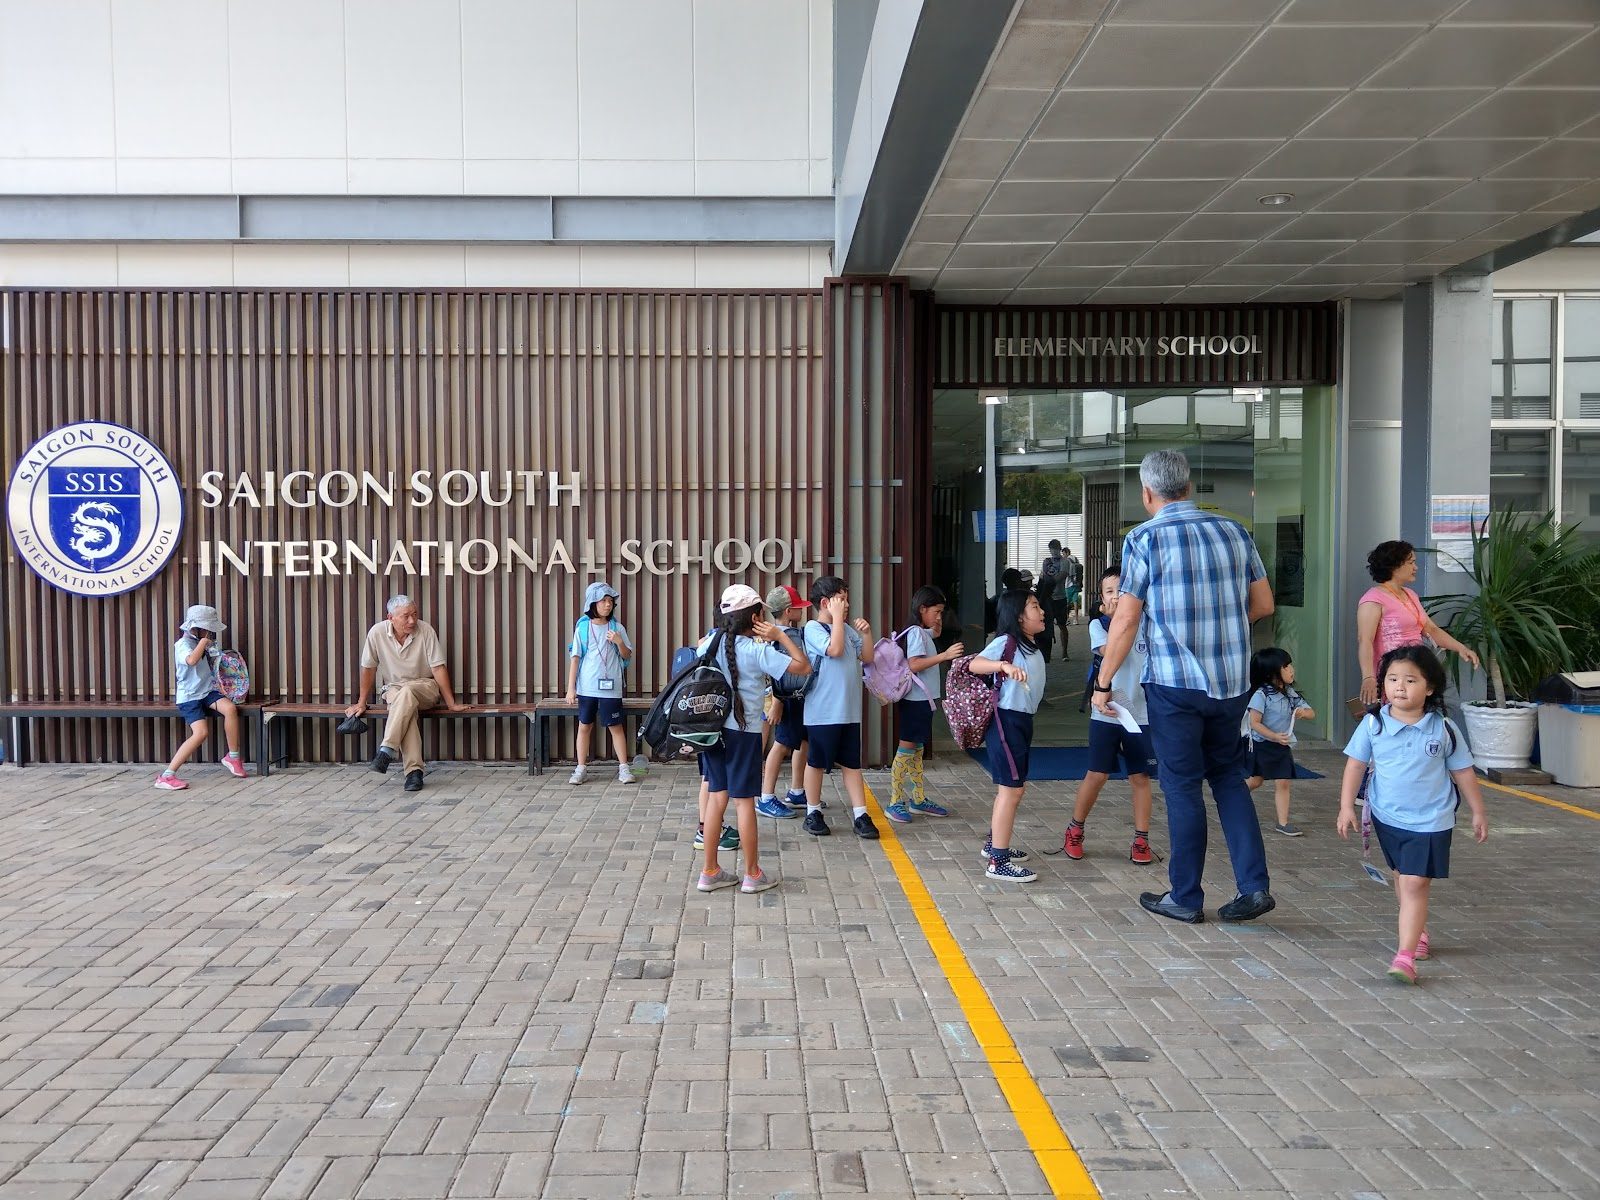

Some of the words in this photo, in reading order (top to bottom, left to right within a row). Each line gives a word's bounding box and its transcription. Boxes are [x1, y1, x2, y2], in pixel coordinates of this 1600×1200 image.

[994, 336, 1151, 357] ELEMENTARY
[1157, 334, 1263, 356] SCHOOL
[20, 428, 94, 483] SAIGON
[105, 430, 169, 483] SOUTH
[65, 473, 123, 492] SSIS
[200, 470, 395, 508] SAIGON
[410, 469, 581, 507] SOUTH
[18, 529, 128, 589] INTERNATIONAL
[132, 529, 173, 578] SCHOOL
[200, 538, 606, 577] INTERNATIONAL
[620, 538, 814, 576] SCHOOL
